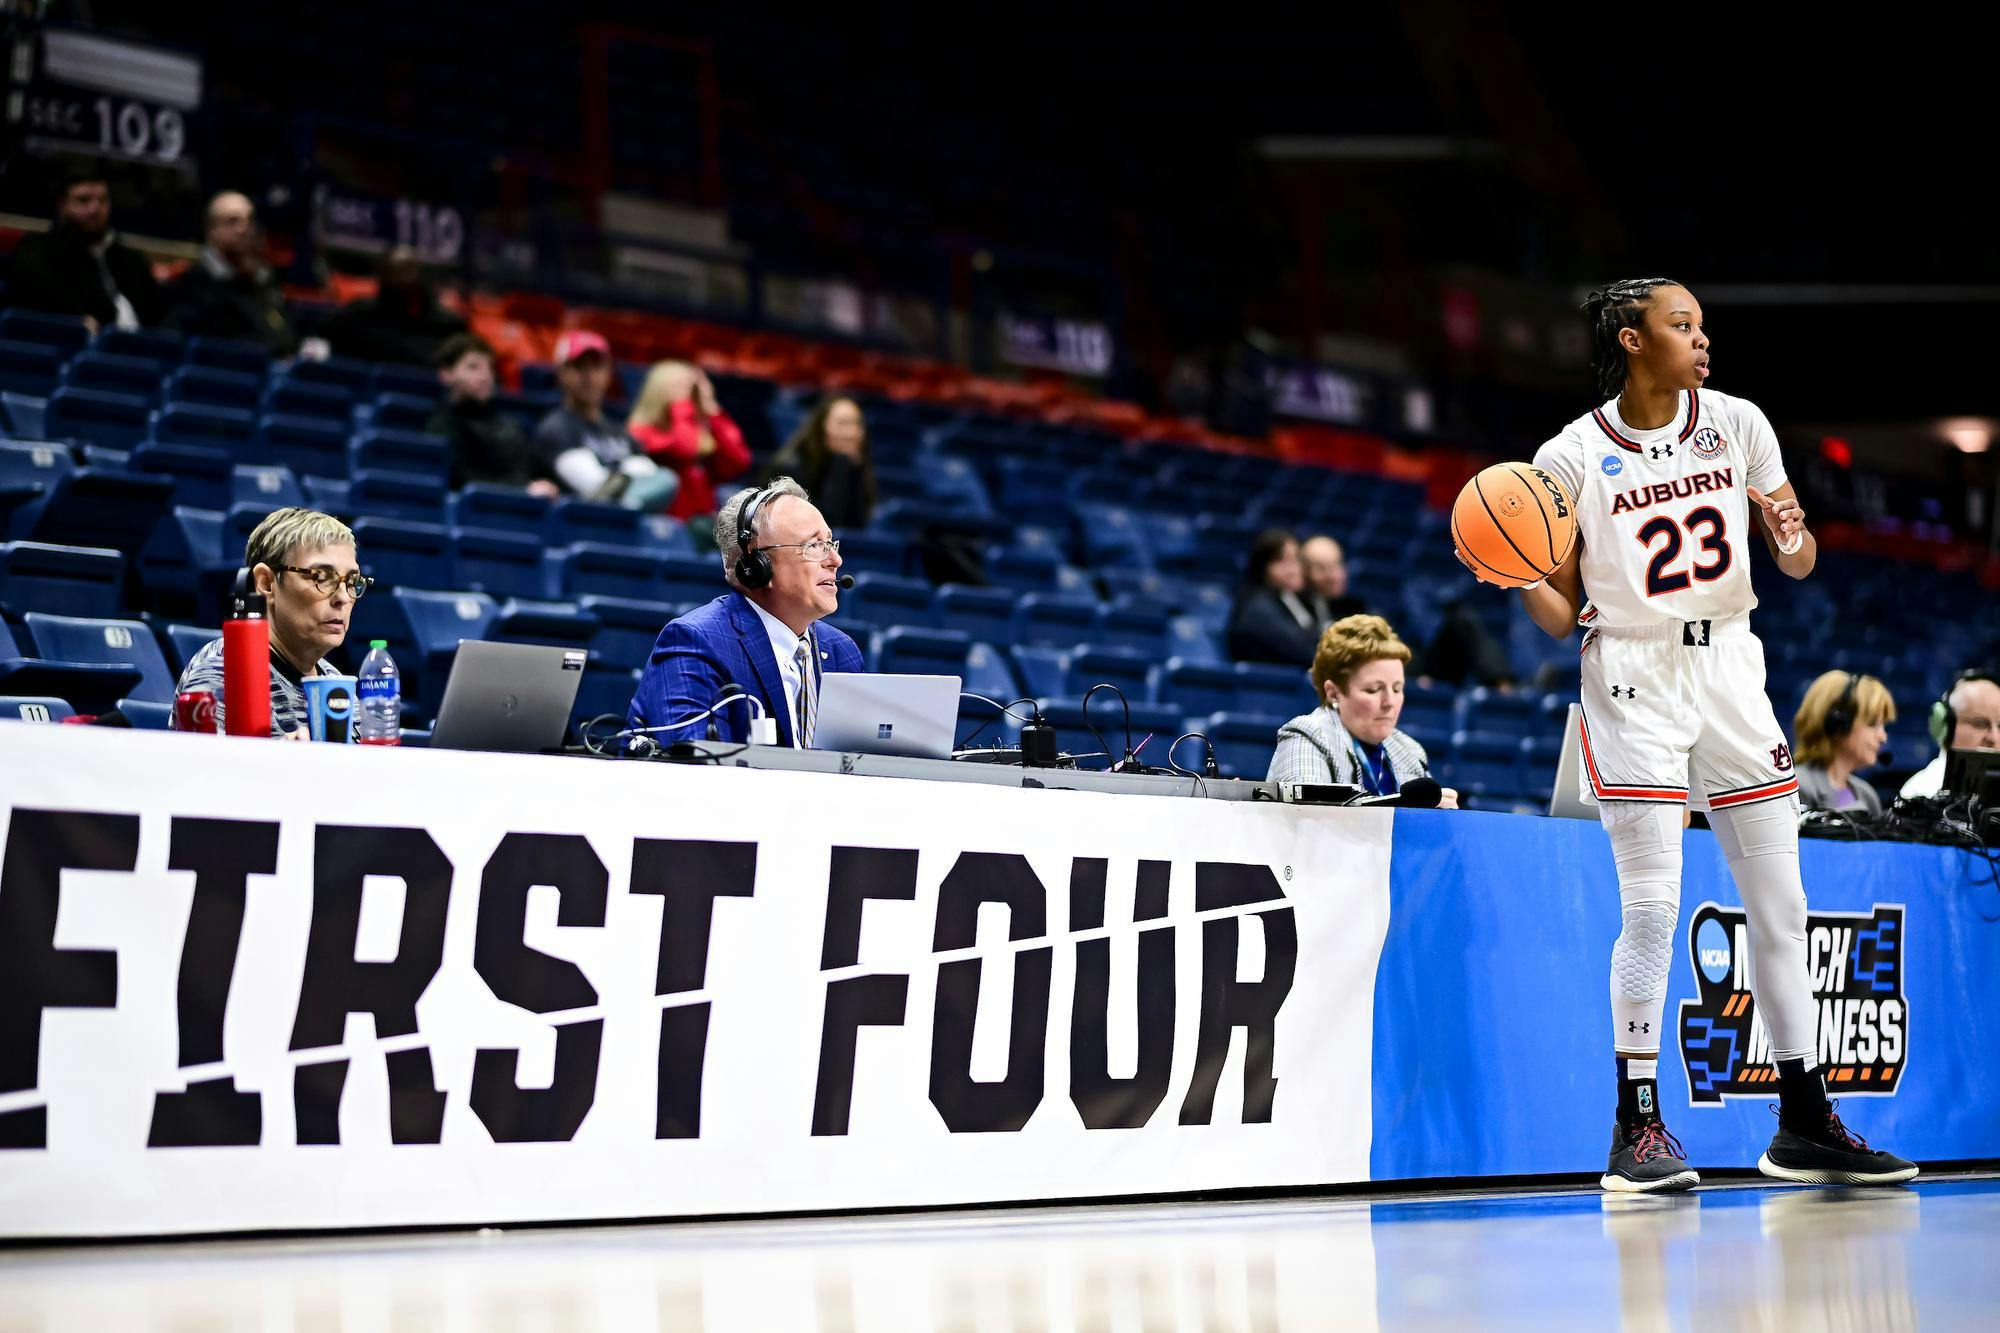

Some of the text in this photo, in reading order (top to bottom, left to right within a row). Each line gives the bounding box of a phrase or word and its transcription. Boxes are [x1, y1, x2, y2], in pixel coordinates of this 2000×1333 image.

[29, 99, 184, 162] SEC 109
[1695, 428, 1720, 452] SEC
[1605, 462, 1622, 472] NCAA
[1611, 467, 1733, 515] AUBURN
[1529, 468, 1568, 518] NCAA
[1636, 505, 1732, 597] 23
[28, 707, 43, 722] 11
[0, 807, 1298, 1149] FIRST FOUR
[1701, 948, 1731, 968] NCAA
